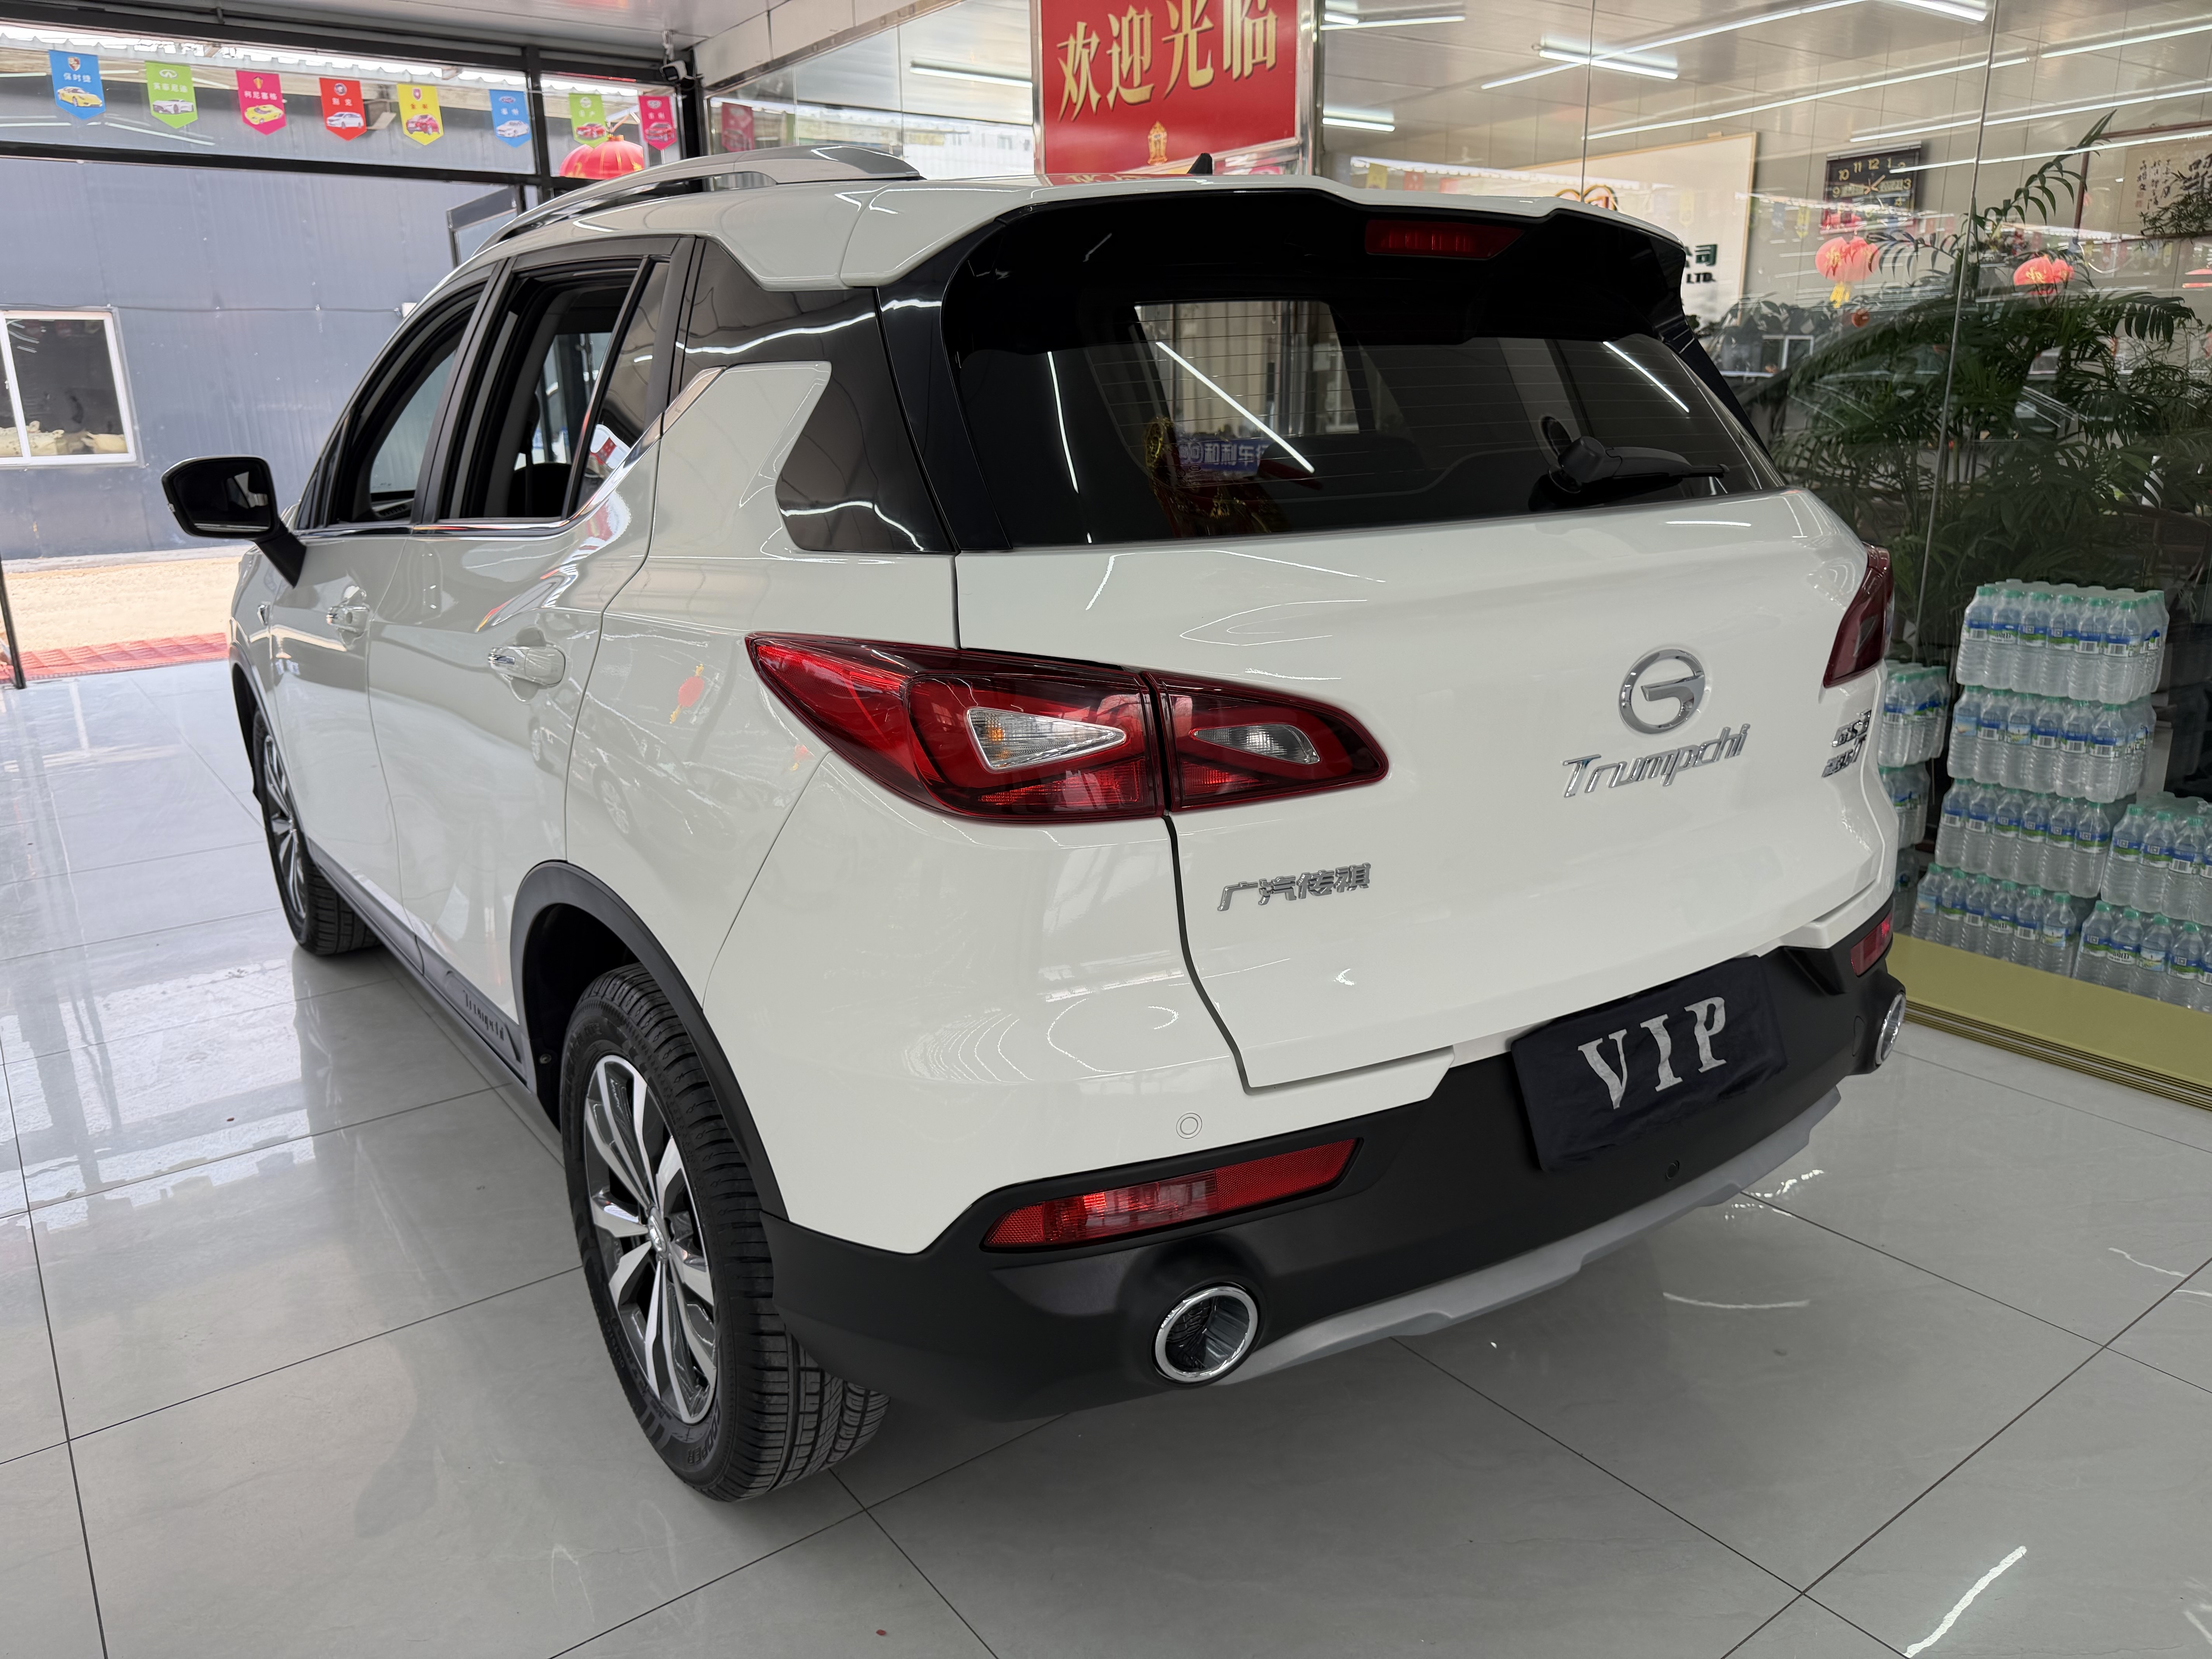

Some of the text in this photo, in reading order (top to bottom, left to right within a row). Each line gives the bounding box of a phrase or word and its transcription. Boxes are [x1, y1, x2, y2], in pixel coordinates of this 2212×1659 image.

[1057, 0, 1278, 121] 欢迎光临
[64, 72, 91, 83] 保时捷
[1838, 168, 1850, 181] 10
[1853, 161, 1862, 173] 11
[1868, 158, 1880, 170] 12
[1561, 723, 1751, 798] Trumpchi
[1217, 862, 1371, 912] 广汽传祺
[1578, 996, 1727, 1109] VIP
